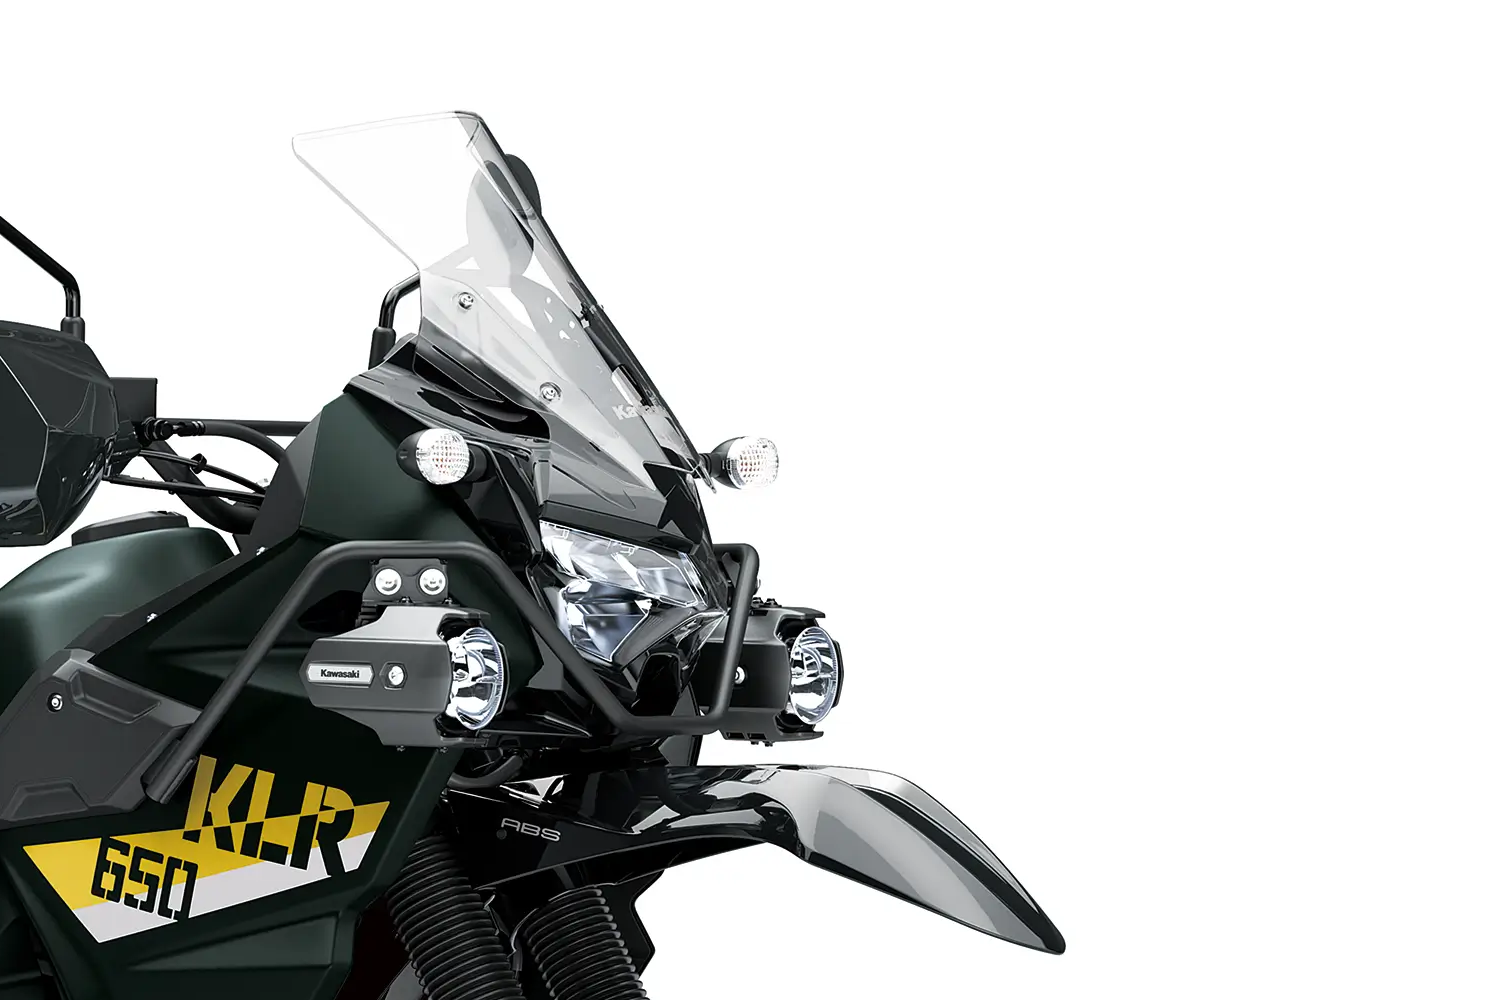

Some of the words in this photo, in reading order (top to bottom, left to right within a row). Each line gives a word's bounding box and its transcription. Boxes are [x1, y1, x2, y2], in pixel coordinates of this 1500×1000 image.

[321, 669, 360, 678] Kawasaki
[182, 754, 355, 876] KLR
[501, 817, 561, 842] ABS
[91, 836, 198, 921] 650
